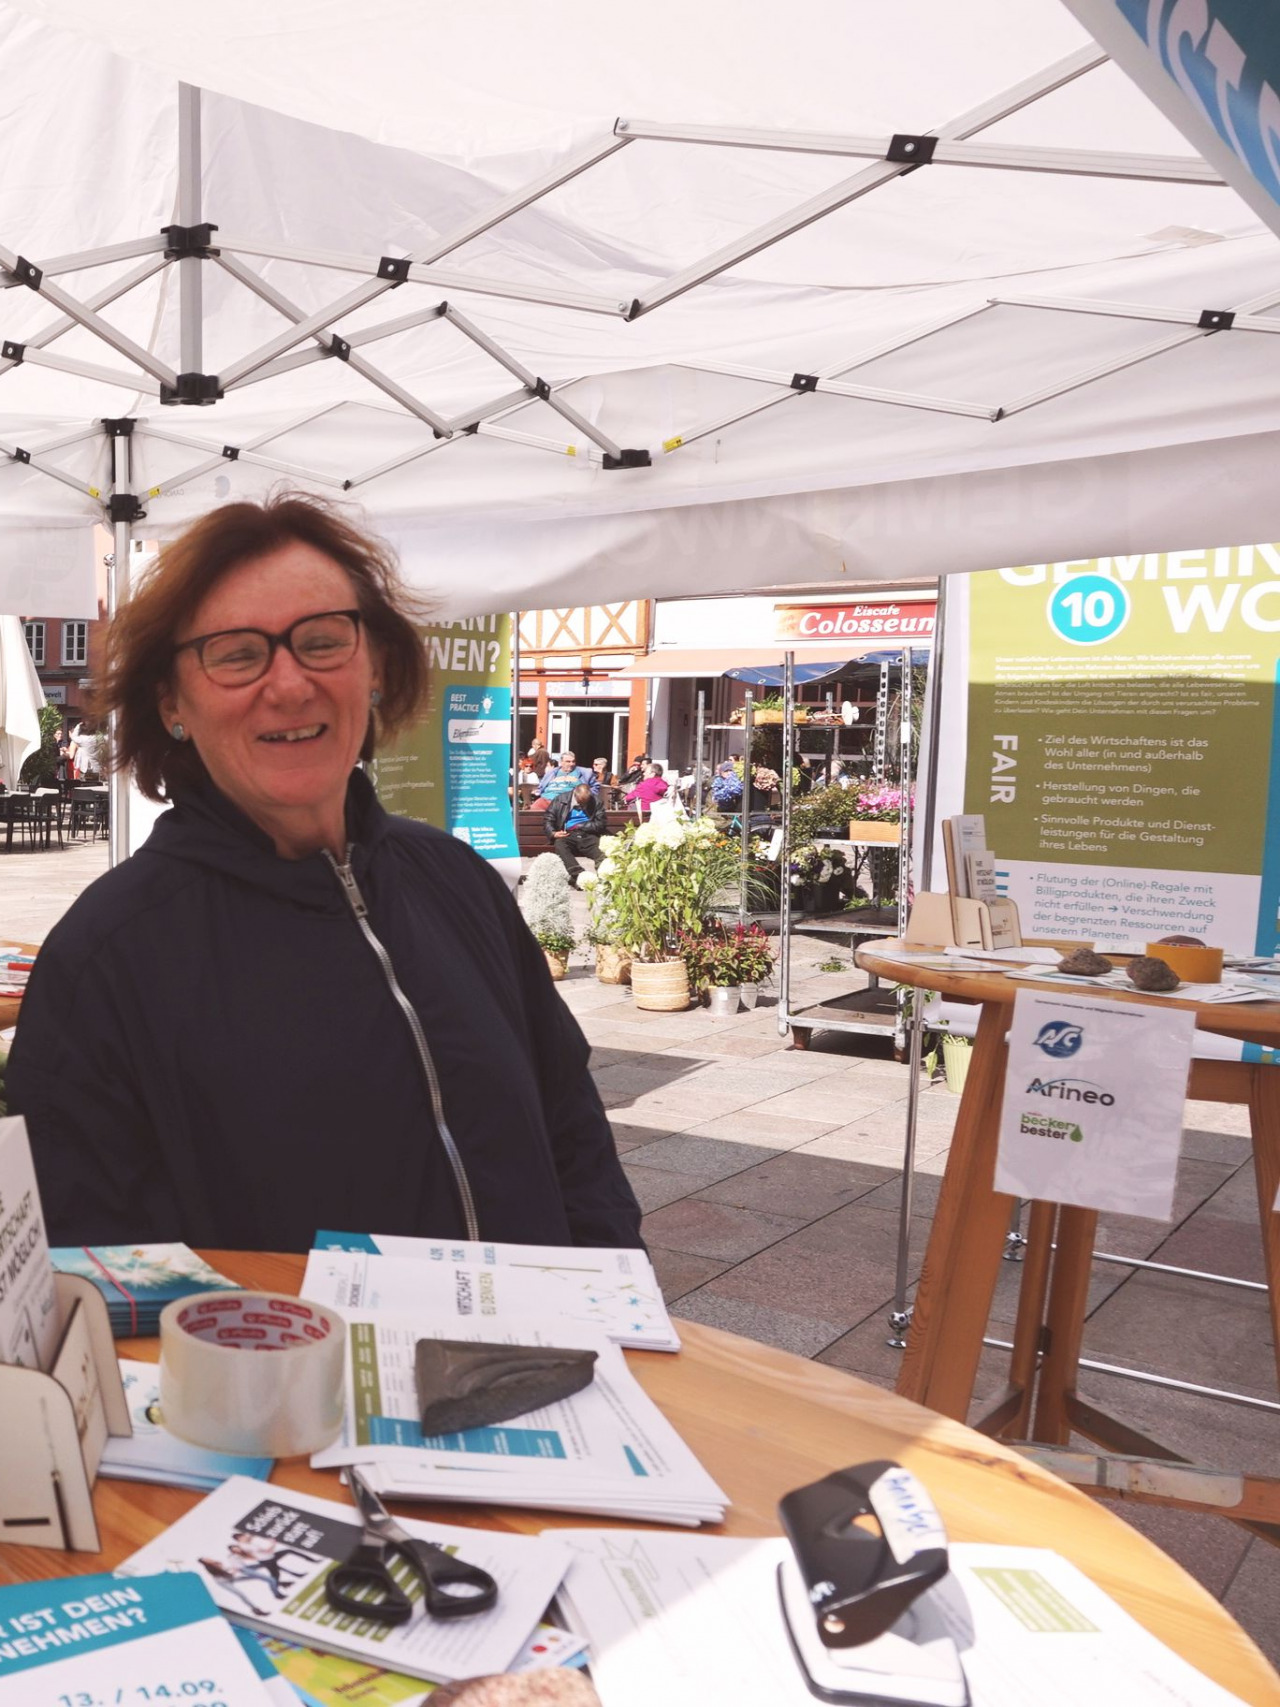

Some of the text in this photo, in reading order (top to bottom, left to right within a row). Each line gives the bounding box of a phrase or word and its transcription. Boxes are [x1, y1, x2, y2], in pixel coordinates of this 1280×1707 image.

[852, 604, 900, 617] Eiscafe
[1061, 590, 1115, 628] 10
[1162, 581, 1280, 633] WO
[424, 636, 501, 673] NEN?
[1045, 735, 1209, 748] Ziel des Wirtschaftens ist das
[1044, 748, 1204, 761] Wohl aller (in und außerhalb
[989, 734, 1019, 804] FAIR
[1044, 760, 1152, 773] des Unternehmens)
[1043, 781, 1201, 796] Herstellung von Dingen, die
[1041, 794, 1144, 806] gebraucht werden
[1041, 814, 1216, 831] Sinnvolle Produkte und Dienst-
[1039, 839, 1108, 852] ihres Lebens
[1040, 826, 1204, 847] leistungen für die Gestaltung
[1037, 873, 1213, 894] Flutung der (Online)-Regale mit
[1036, 886, 1216, 908] Billigprodukten, die ihren Zweck
[1034, 899, 1214, 923] nicht erfüllen Verschwendung
[1032, 924, 1129, 940] unserem Planeten
[1033, 911, 1208, 934] der begrenzten Ressourcen auf
[1025, 1077, 1115, 1106] Arineo
[1020, 1123, 1068, 1140] bester
[9, 1608, 57, 1634] IST
[61, 1586, 143, 1619] DEIN
[136, 1679, 223, 1701] 14.09.
